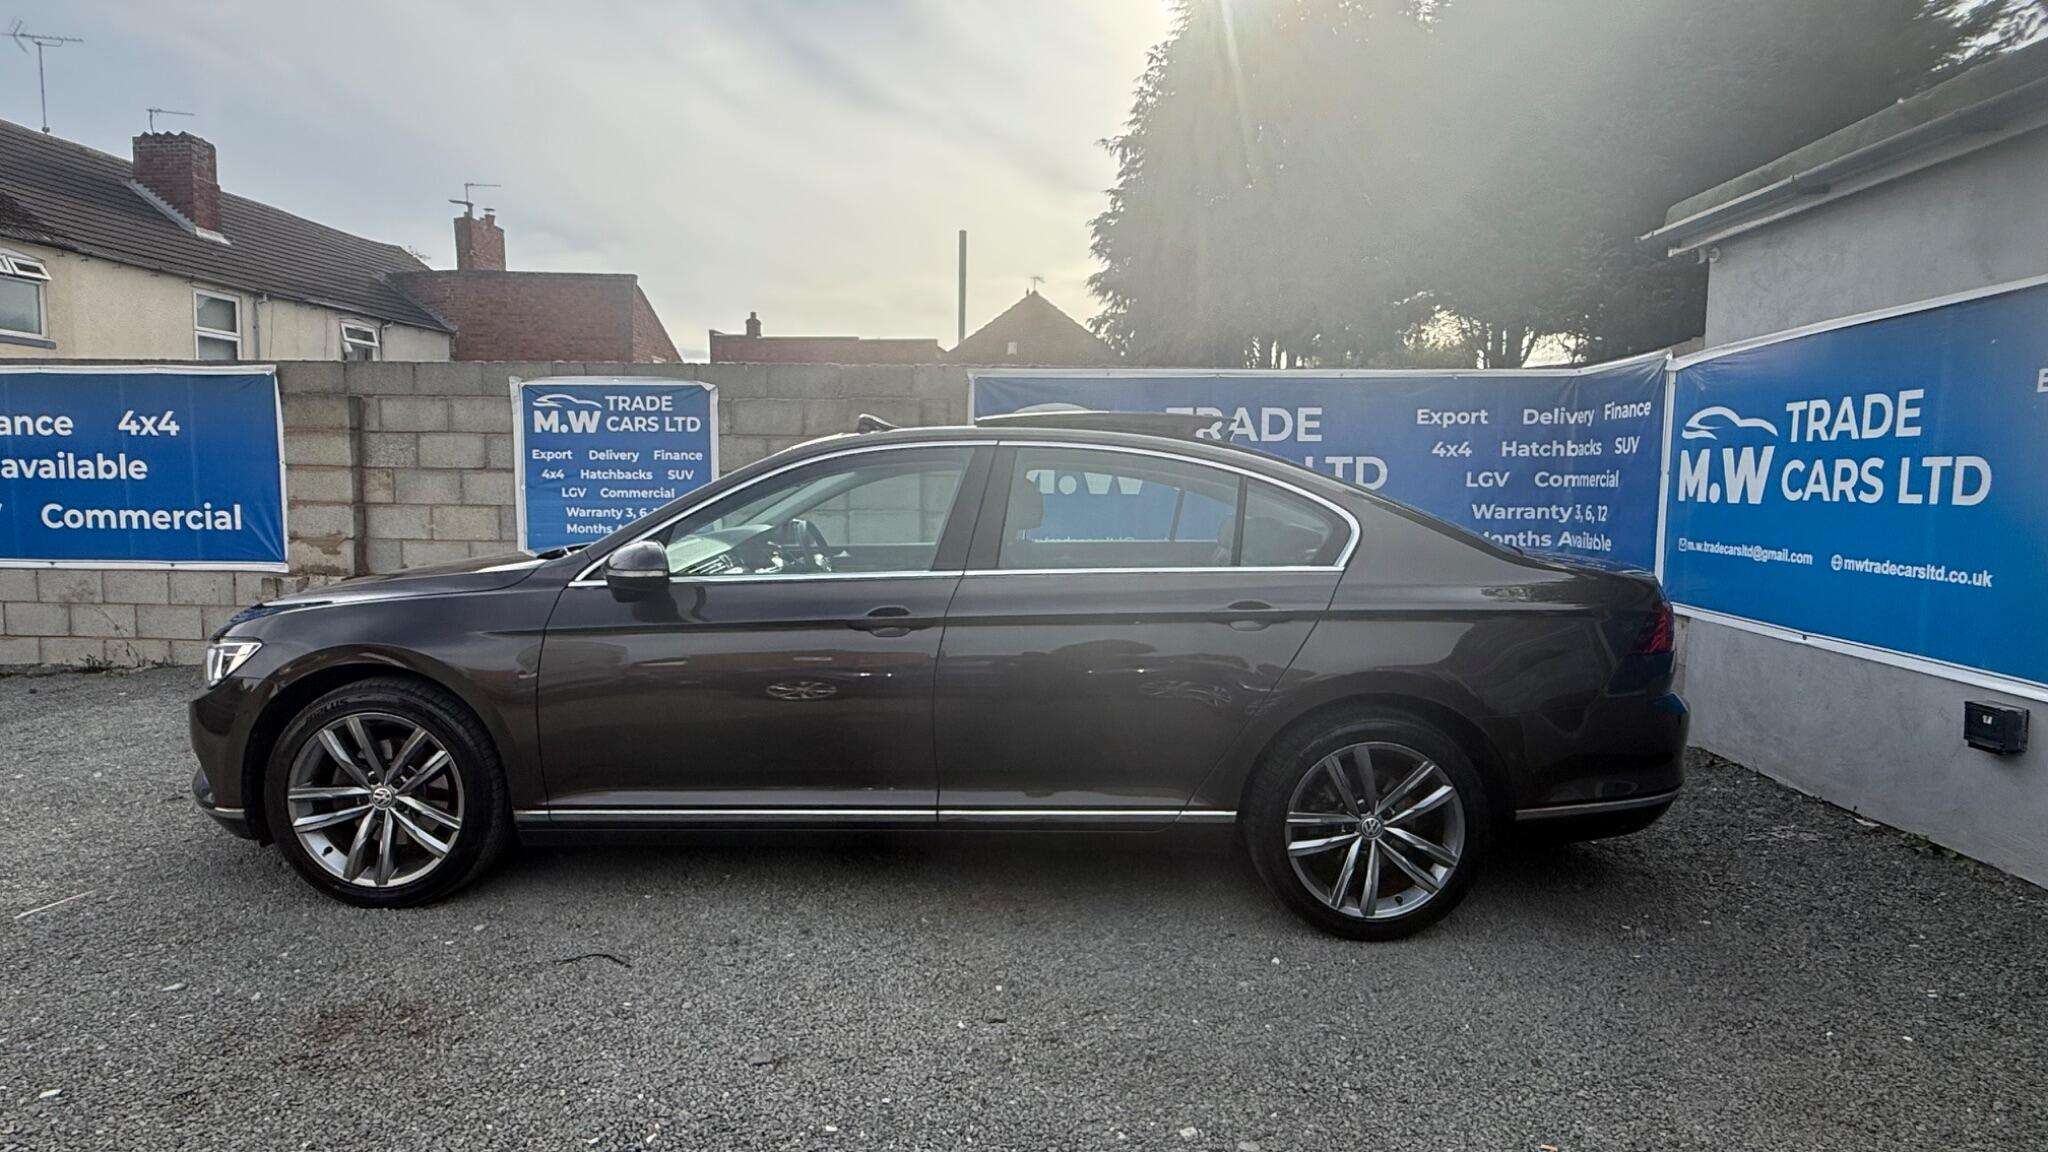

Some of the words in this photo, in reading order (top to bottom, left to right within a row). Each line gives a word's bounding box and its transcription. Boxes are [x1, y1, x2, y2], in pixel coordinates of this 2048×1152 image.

[605, 396, 673, 411] TRADE
[118, 410, 180, 436] 4x4
[533, 410, 601, 433] M.W
[606, 416, 659, 432] CARS
[665, 417, 701, 432] LTD
[1416, 408, 1489, 428] Export
[1523, 408, 1595, 427] Delivery
[1604, 401, 1651, 421] Finance
[1786, 389, 1925, 443] TRADE
[532, 449, 573, 462] Export
[588, 450, 640, 463] Delivery
[653, 450, 703, 461] Finance
[1432, 441, 1472, 457] 4x4
[1501, 439, 1602, 457] Hatchbacks
[1614, 436, 1640, 454] SUV
[1, 452, 148, 479] available
[541, 469, 565, 480] 4x4
[580, 469, 653, 480] Hatchbacks
[667, 470, 694, 480] SUV
[1677, 445, 1776, 505] M.W
[1466, 472, 1510, 488] LGV
[1534, 470, 1619, 488] Commercial
[1781, 457, 1885, 504] CARS
[1898, 455, 1992, 506] LTD
[561, 488, 587, 498] LGV
[600, 487, 675, 499] Commercial
[41, 503, 242, 530] Commercial
[566, 507, 623, 520] Warranty
[625, 508, 636, 519] 3,
[1472, 504, 1573, 523] Warranty
[1575, 504, 1583, 523] 3,
[1585, 504, 1595, 524] 6,
[1598, 505, 1608, 522] 12
[566, 523, 613, 534] Months
[1483, 530, 1552, 547] onths
[1557, 531, 1612, 552] Available
[1844, 557, 1993, 588] mwtradecarsltd.co.uk
